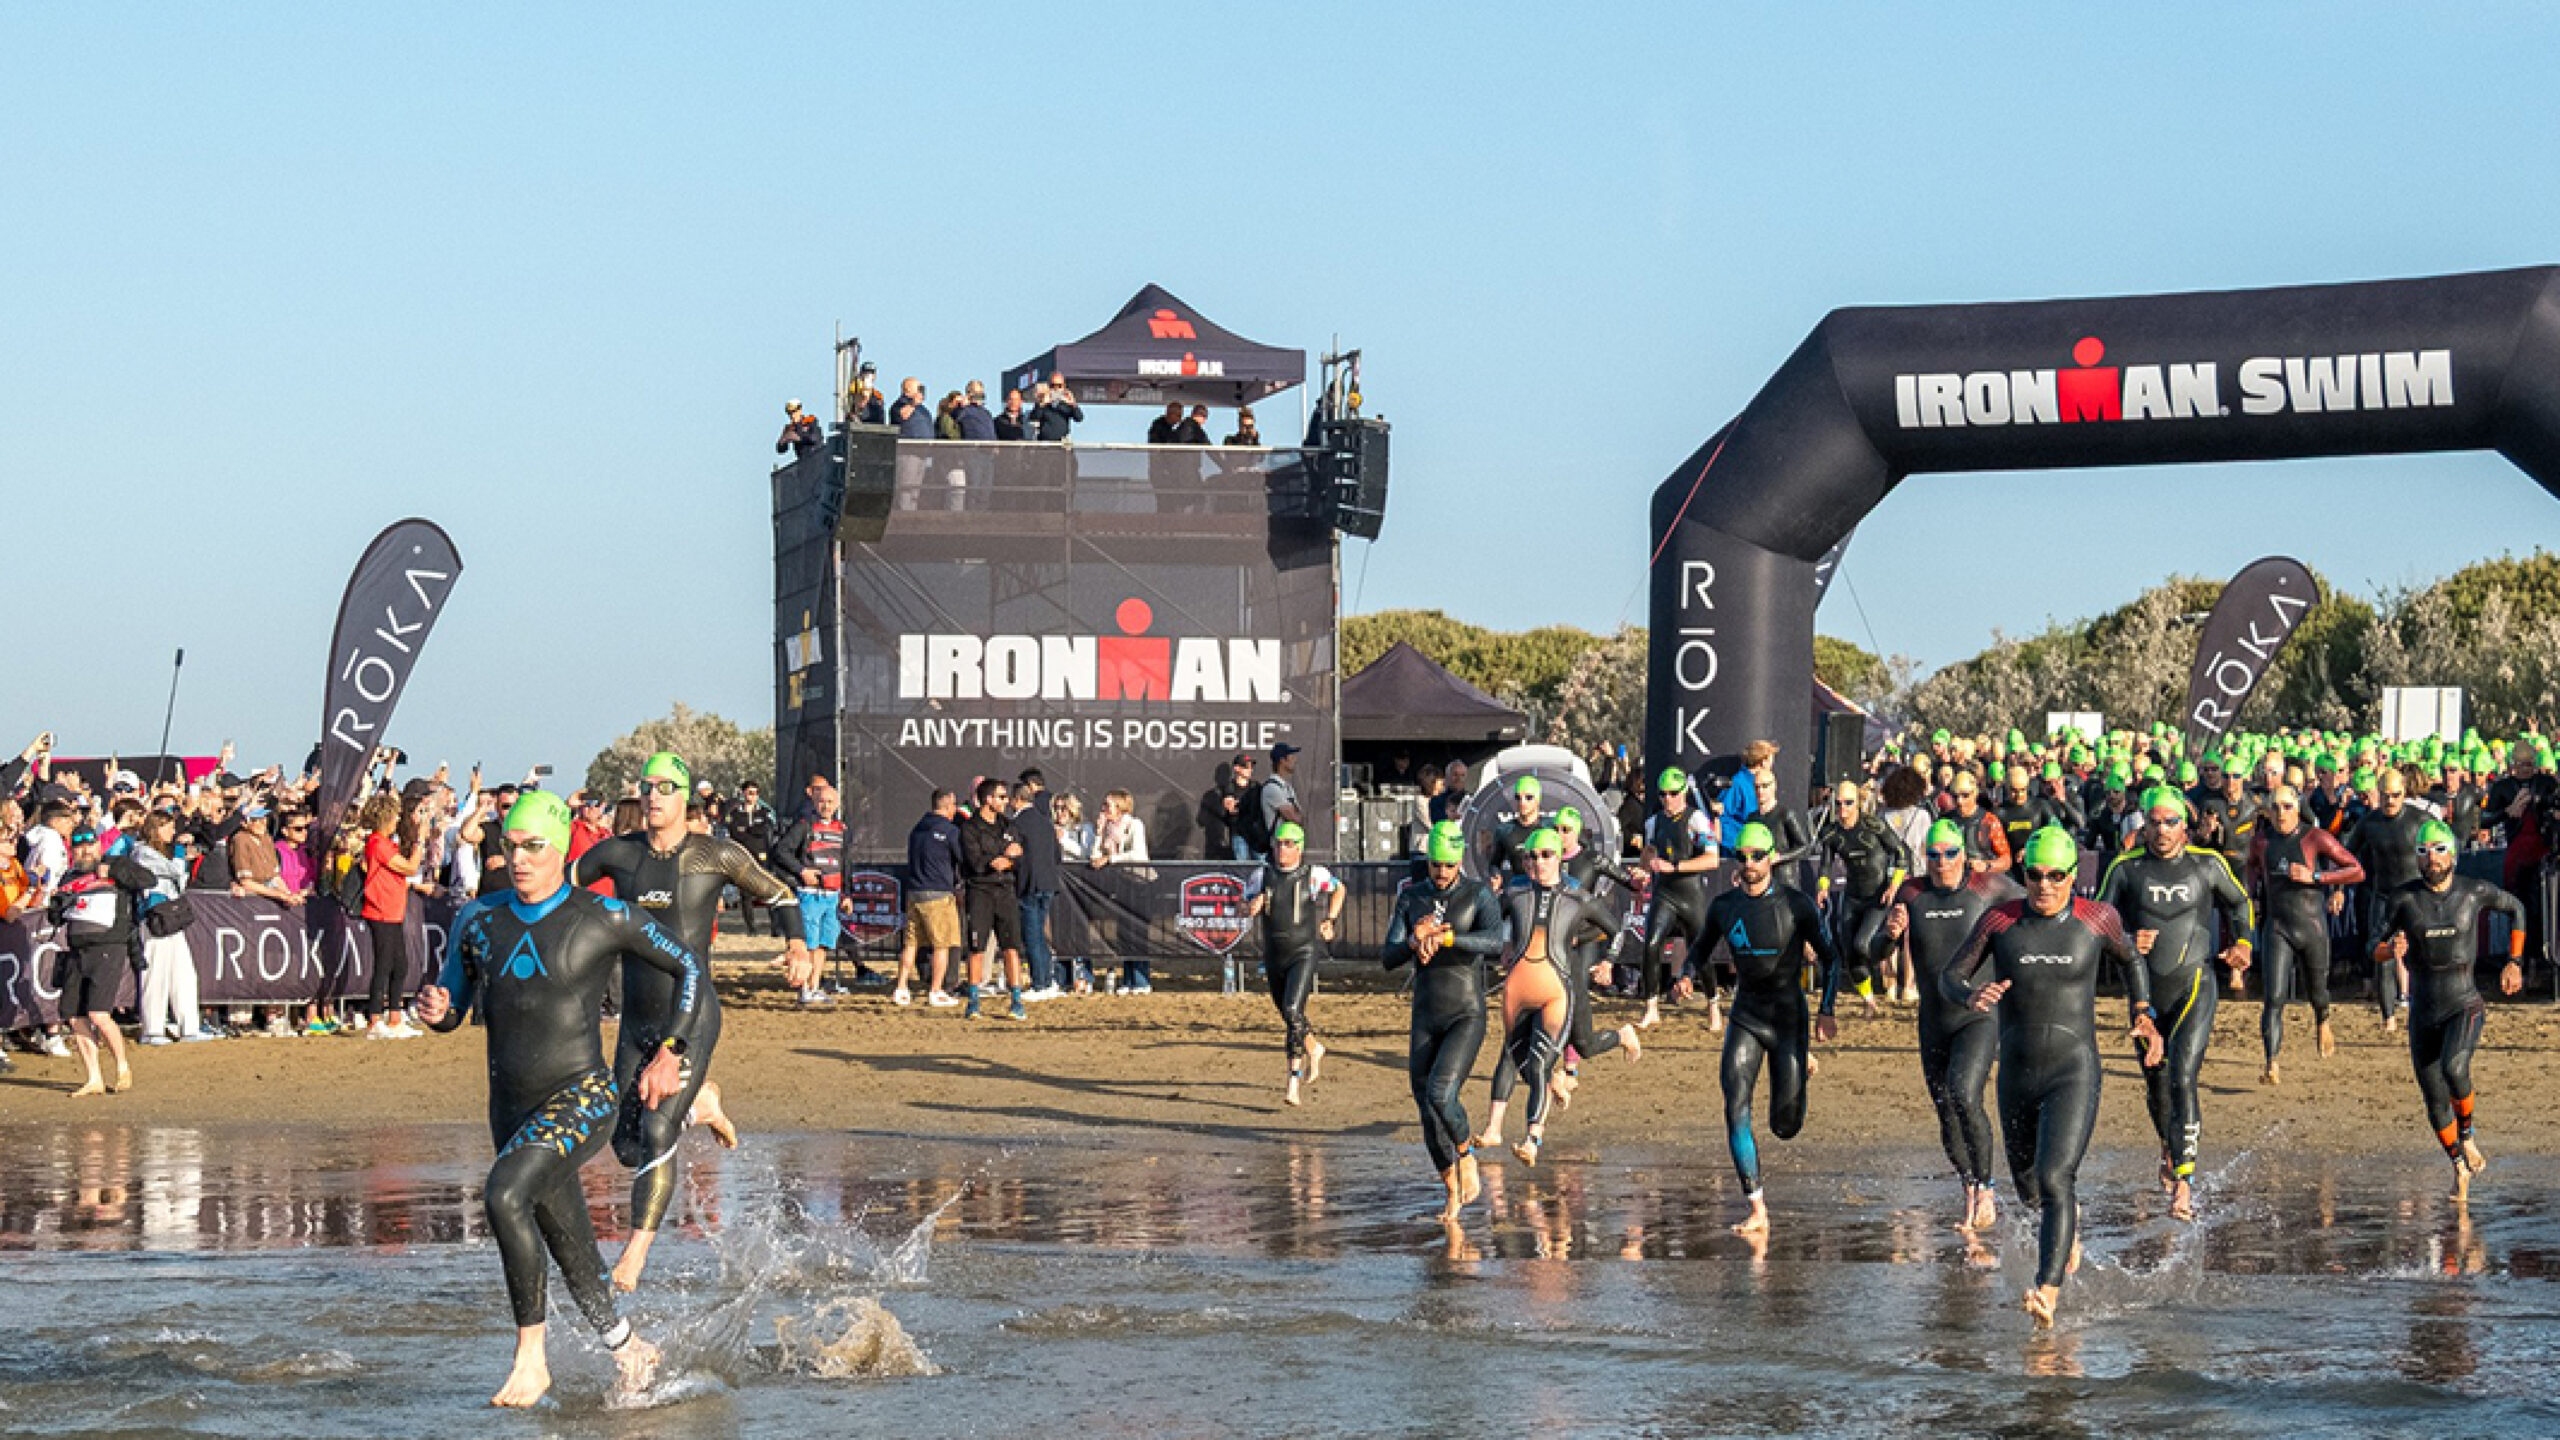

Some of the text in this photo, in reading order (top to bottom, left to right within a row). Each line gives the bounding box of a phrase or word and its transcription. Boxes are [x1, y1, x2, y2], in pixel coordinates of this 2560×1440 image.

[2239, 350, 2454, 416] SWIM
[900, 718, 1074, 750] ANYTHING
[1085, 719, 1114, 749] IS
[2149, 886, 2191, 902] TYR
